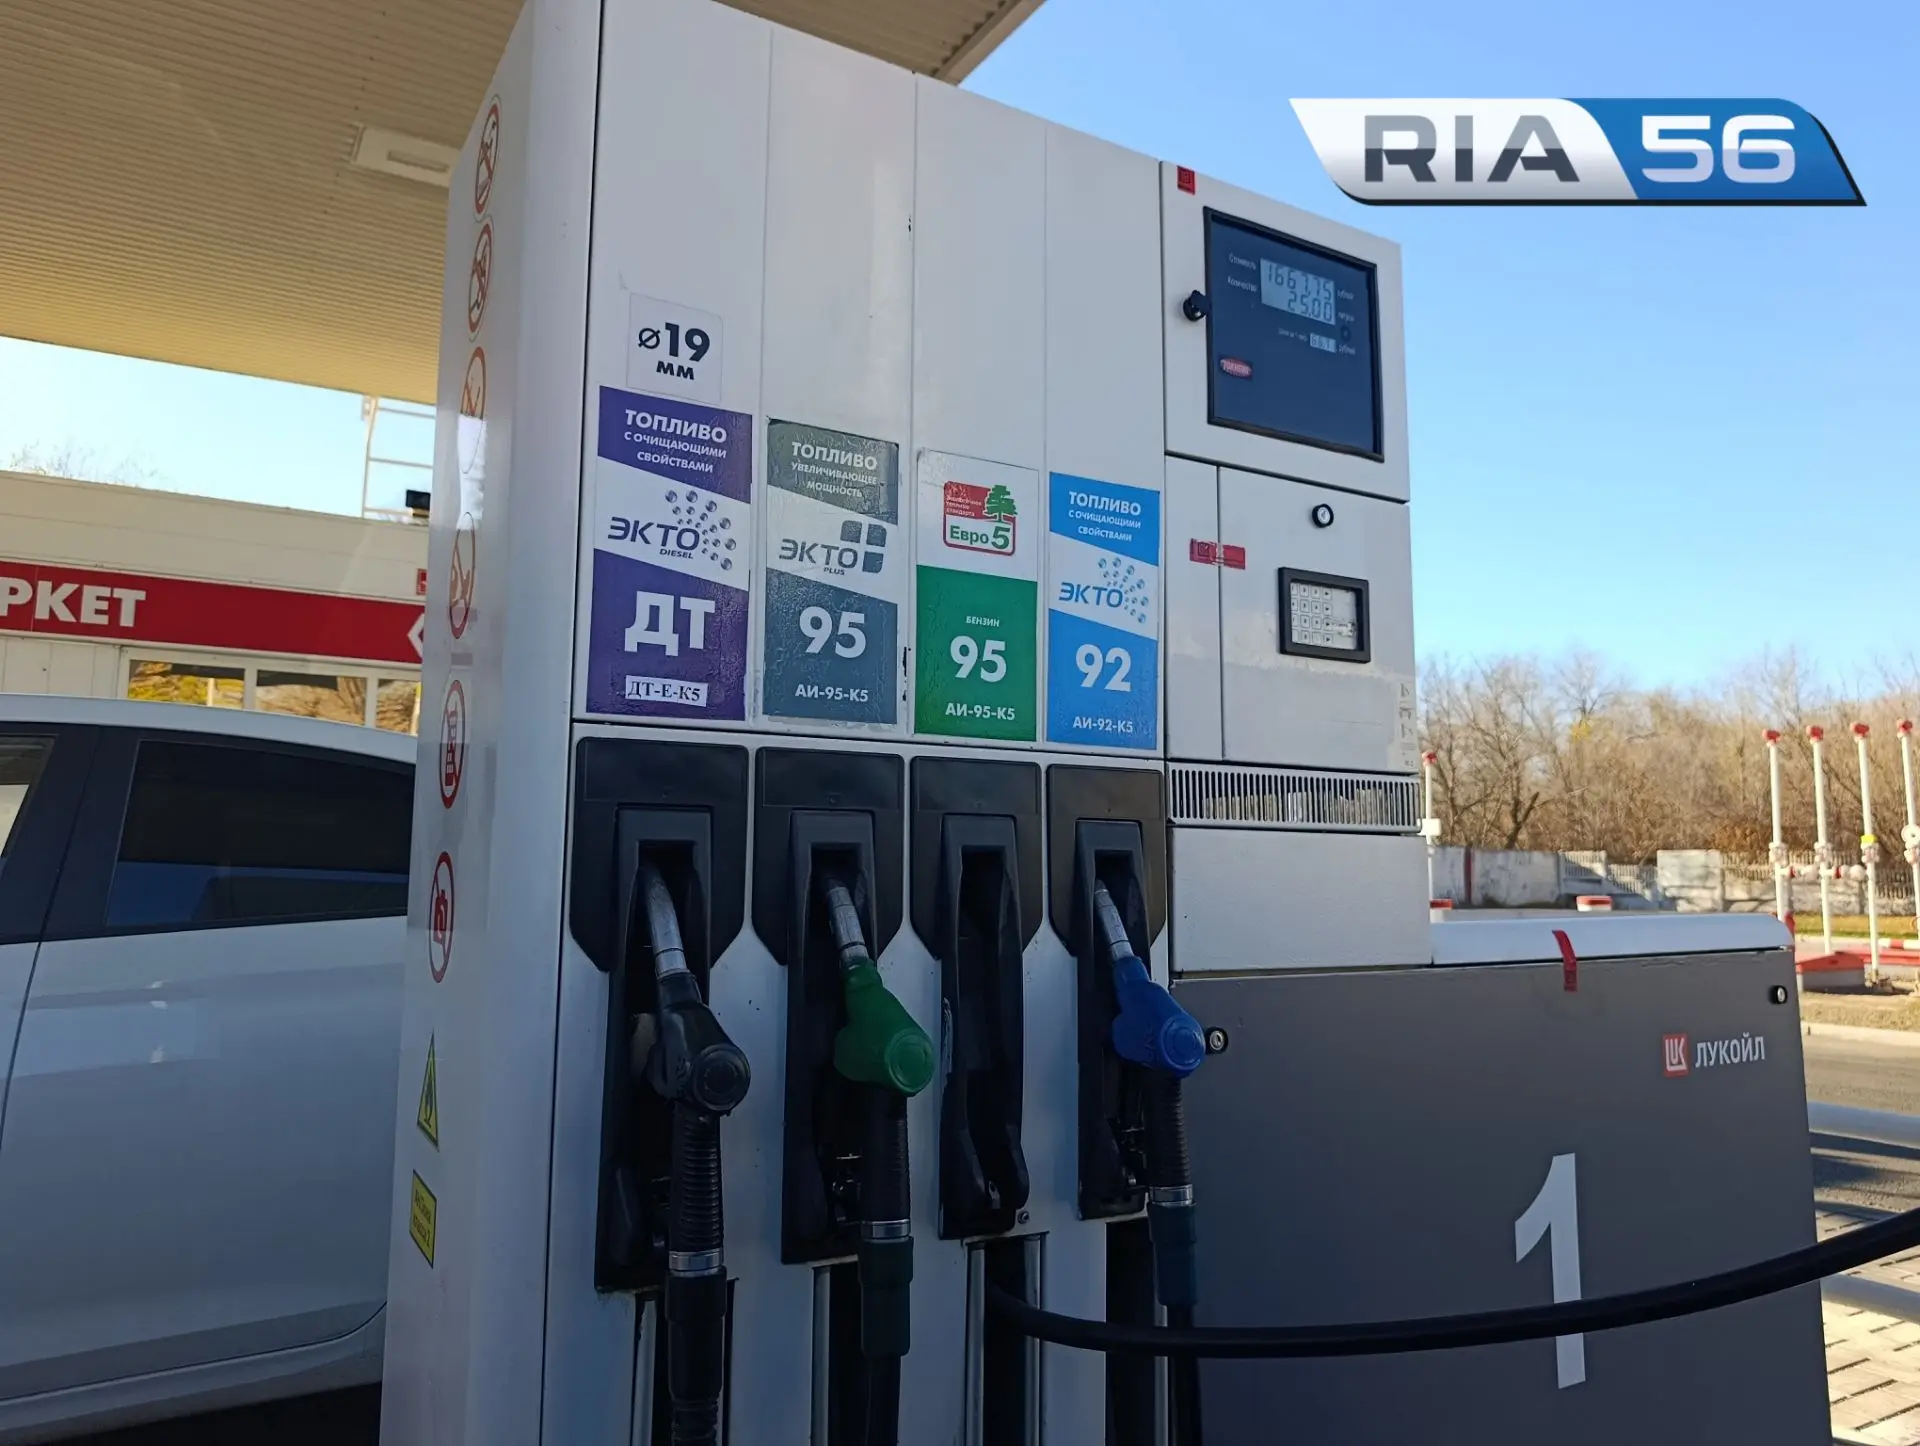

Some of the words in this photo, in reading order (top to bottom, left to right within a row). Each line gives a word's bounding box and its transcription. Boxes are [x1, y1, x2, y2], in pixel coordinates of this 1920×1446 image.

[625, 409, 727, 443] ТОПЛИВО
[624, 431, 632, 440] С
[633, 433, 727, 459] ОЧИЩАЮЩИМИ
[792, 441, 878, 470] ТОПЛИВО
[637, 451, 713, 473] СВОЙСТВАМИ
[791, 461, 878, 485] УВЕЛИЧИВАЮЩЕЕ
[806, 480, 863, 498] МОЩНОСТЬ
[1068, 491, 1141, 516] ТОПЛИВО
[1075, 510, 1141, 529] ОЧИЩАЮЩИМИ
[608, 516, 700, 550] ЭКТО
[950, 525, 989, 545] Евро
[991, 526, 1011, 550] 5
[1078, 525, 1132, 542] СВОЙСТВАМИ
[660, 548, 694, 559] DIESEL
[779, 538, 858, 569] ЭКТО
[824, 567, 845, 576] PLUS
[1059, 582, 1123, 608] ЭКТО
[624, 590, 715, 656] ДТ
[800, 606, 866, 658] 95
[966, 615, 1000, 627] БЕНЗИН
[950, 635, 1007, 683] 95
[1075, 644, 1131, 692] 92
[628, 681, 700, 702] ДТ-Е-К5
[795, 684, 869, 702] АИ-95-К5
[945, 702, 1015, 720] АИ-95-К5
[1073, 716, 1133, 733] АИ-92-К5
[1695, 1032, 1765, 1068] ЛУКОЙЛ
[1515, 1152, 1586, 1389] 1
